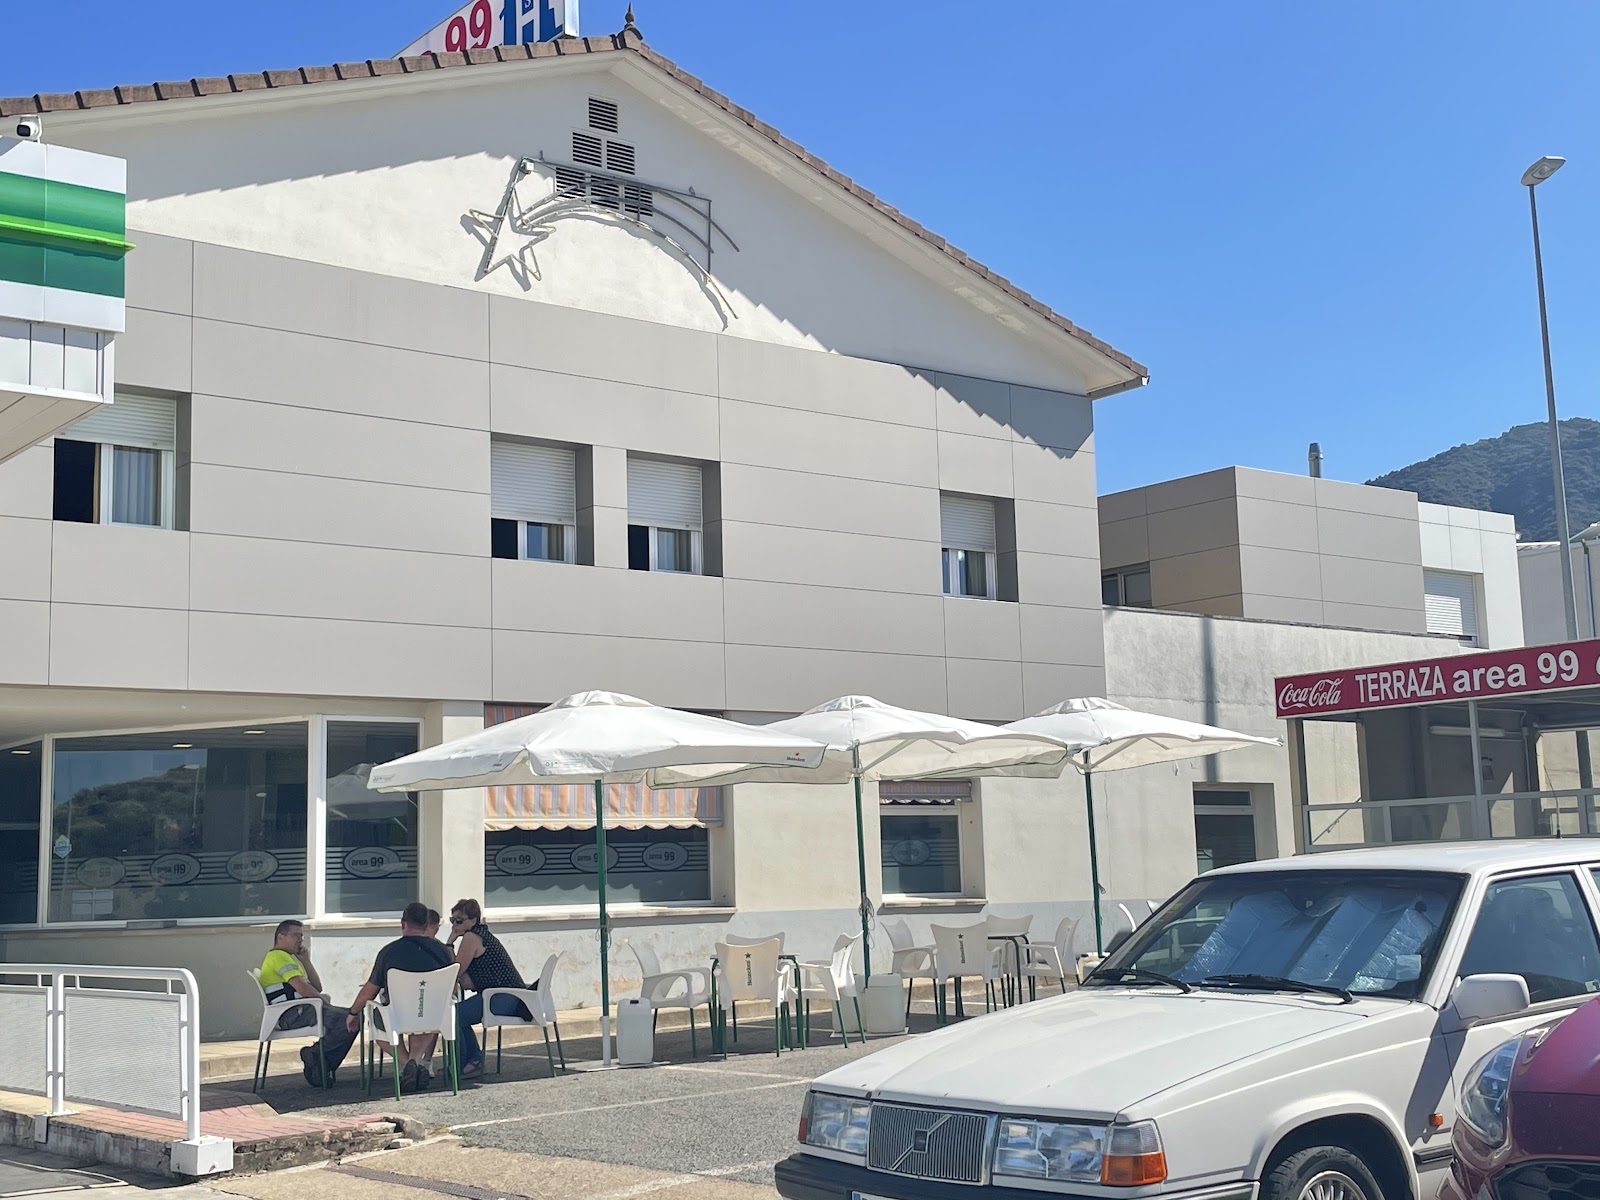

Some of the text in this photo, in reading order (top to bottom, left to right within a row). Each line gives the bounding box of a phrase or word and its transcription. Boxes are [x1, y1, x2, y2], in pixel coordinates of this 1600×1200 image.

[445, 0, 492, 52] 99
[1278, 678, 1344, 710] Coca-Cola
[1355, 665, 1447, 703] TERRAZA
[1452, 663, 1527, 693] area
[1537, 649, 1579, 684] 99
[370, 856, 384, 867] 99
[519, 854, 531, 865] 99
[664, 851, 675, 861] 99
